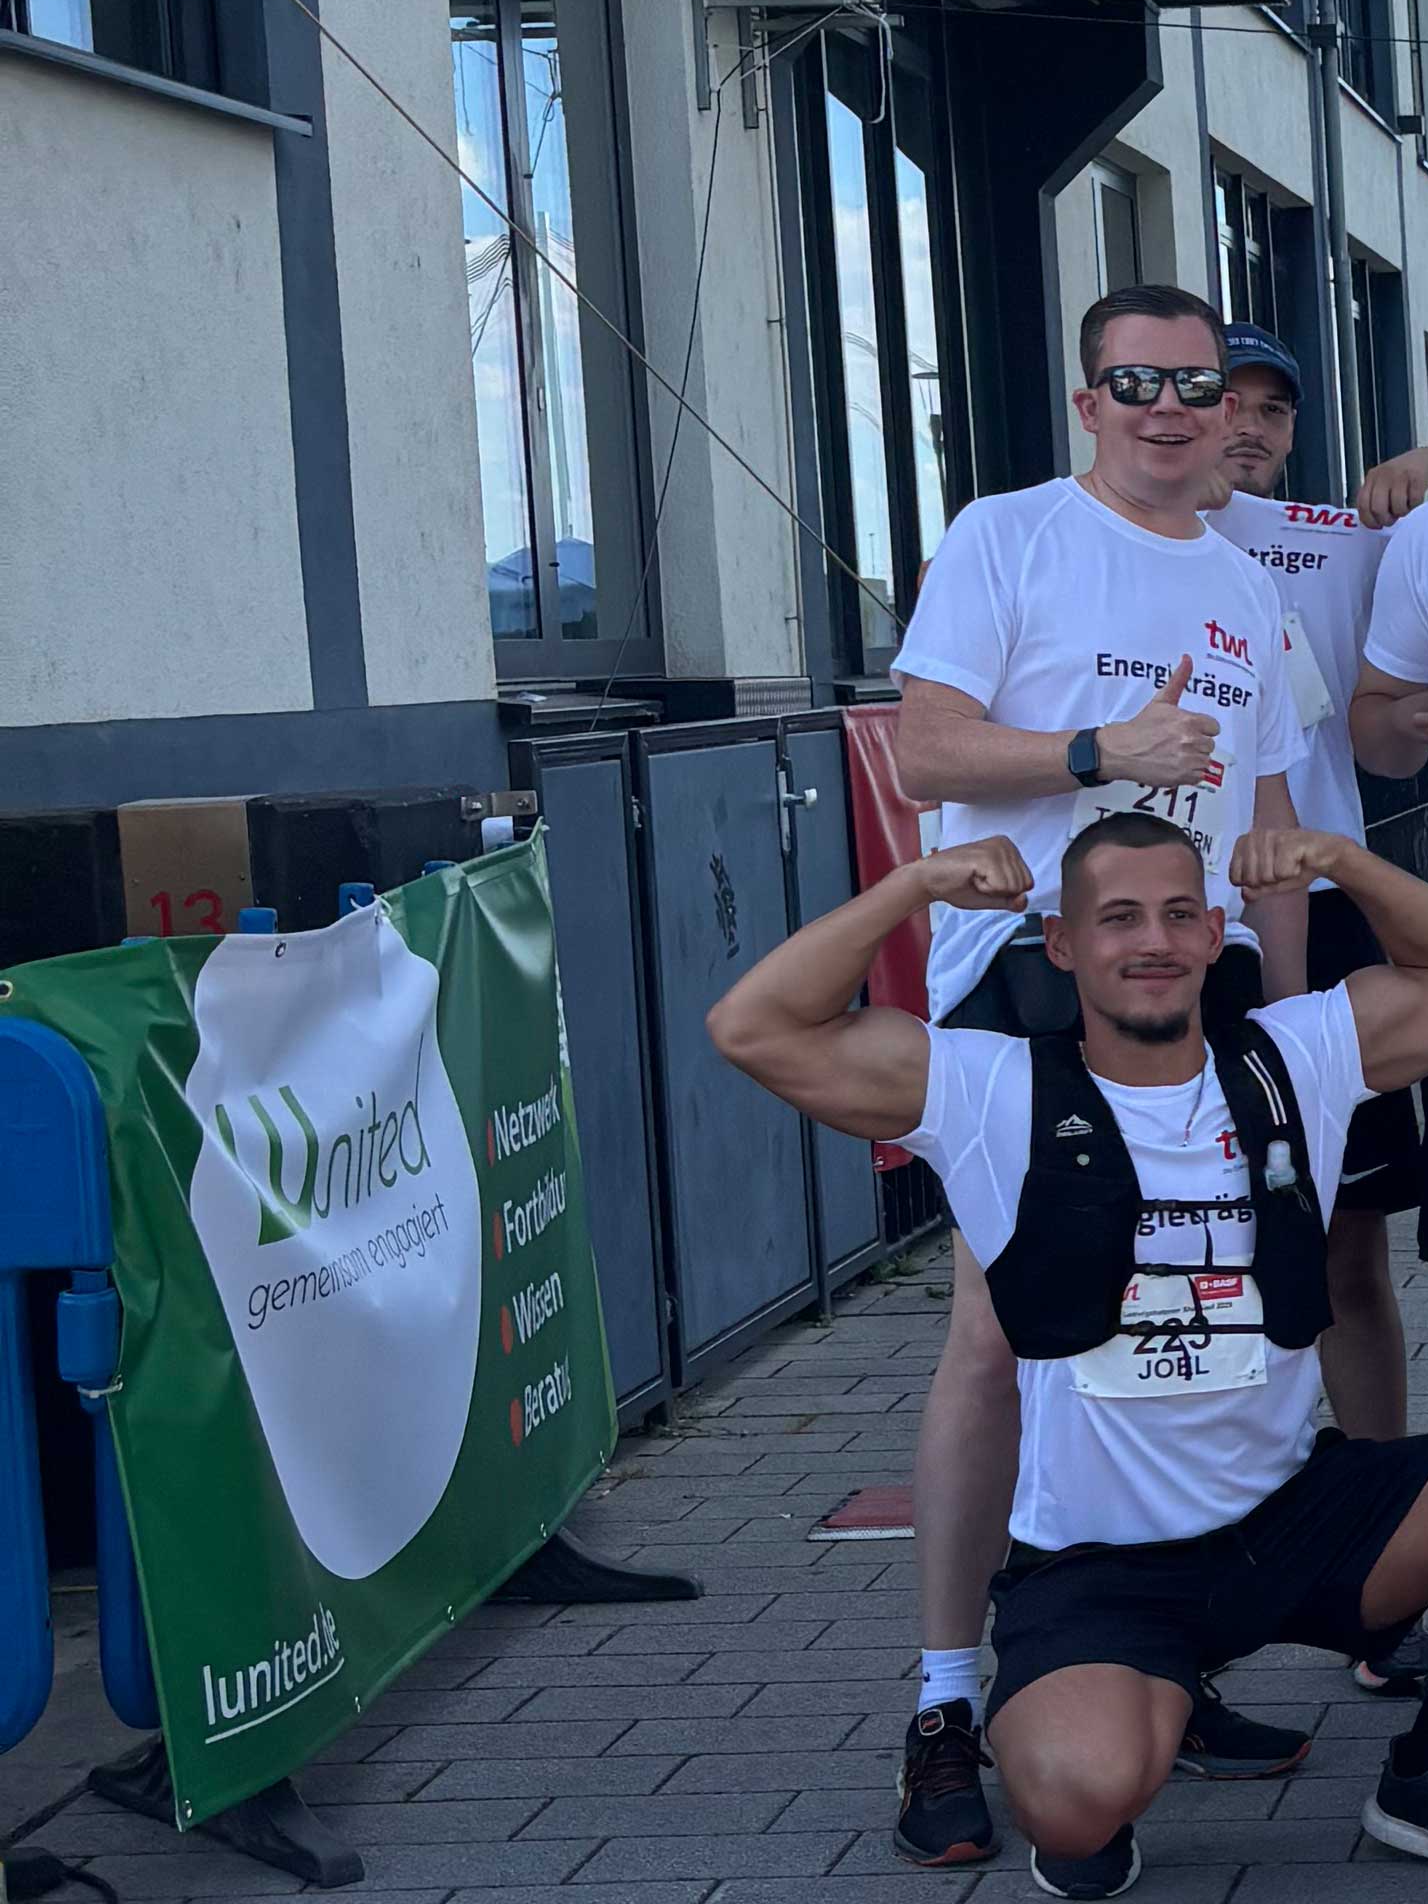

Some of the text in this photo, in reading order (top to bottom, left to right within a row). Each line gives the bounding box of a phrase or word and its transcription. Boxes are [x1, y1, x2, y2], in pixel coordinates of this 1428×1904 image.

[1205, 619, 1253, 666] twl
[1133, 783, 1199, 823] 211
[367, 1192, 449, 1269] engagiert
[512, 1271, 564, 1345] Wissen
[1138, 1355, 1210, 1380] JOEL
[203, 1601, 340, 1726] lunited.de
